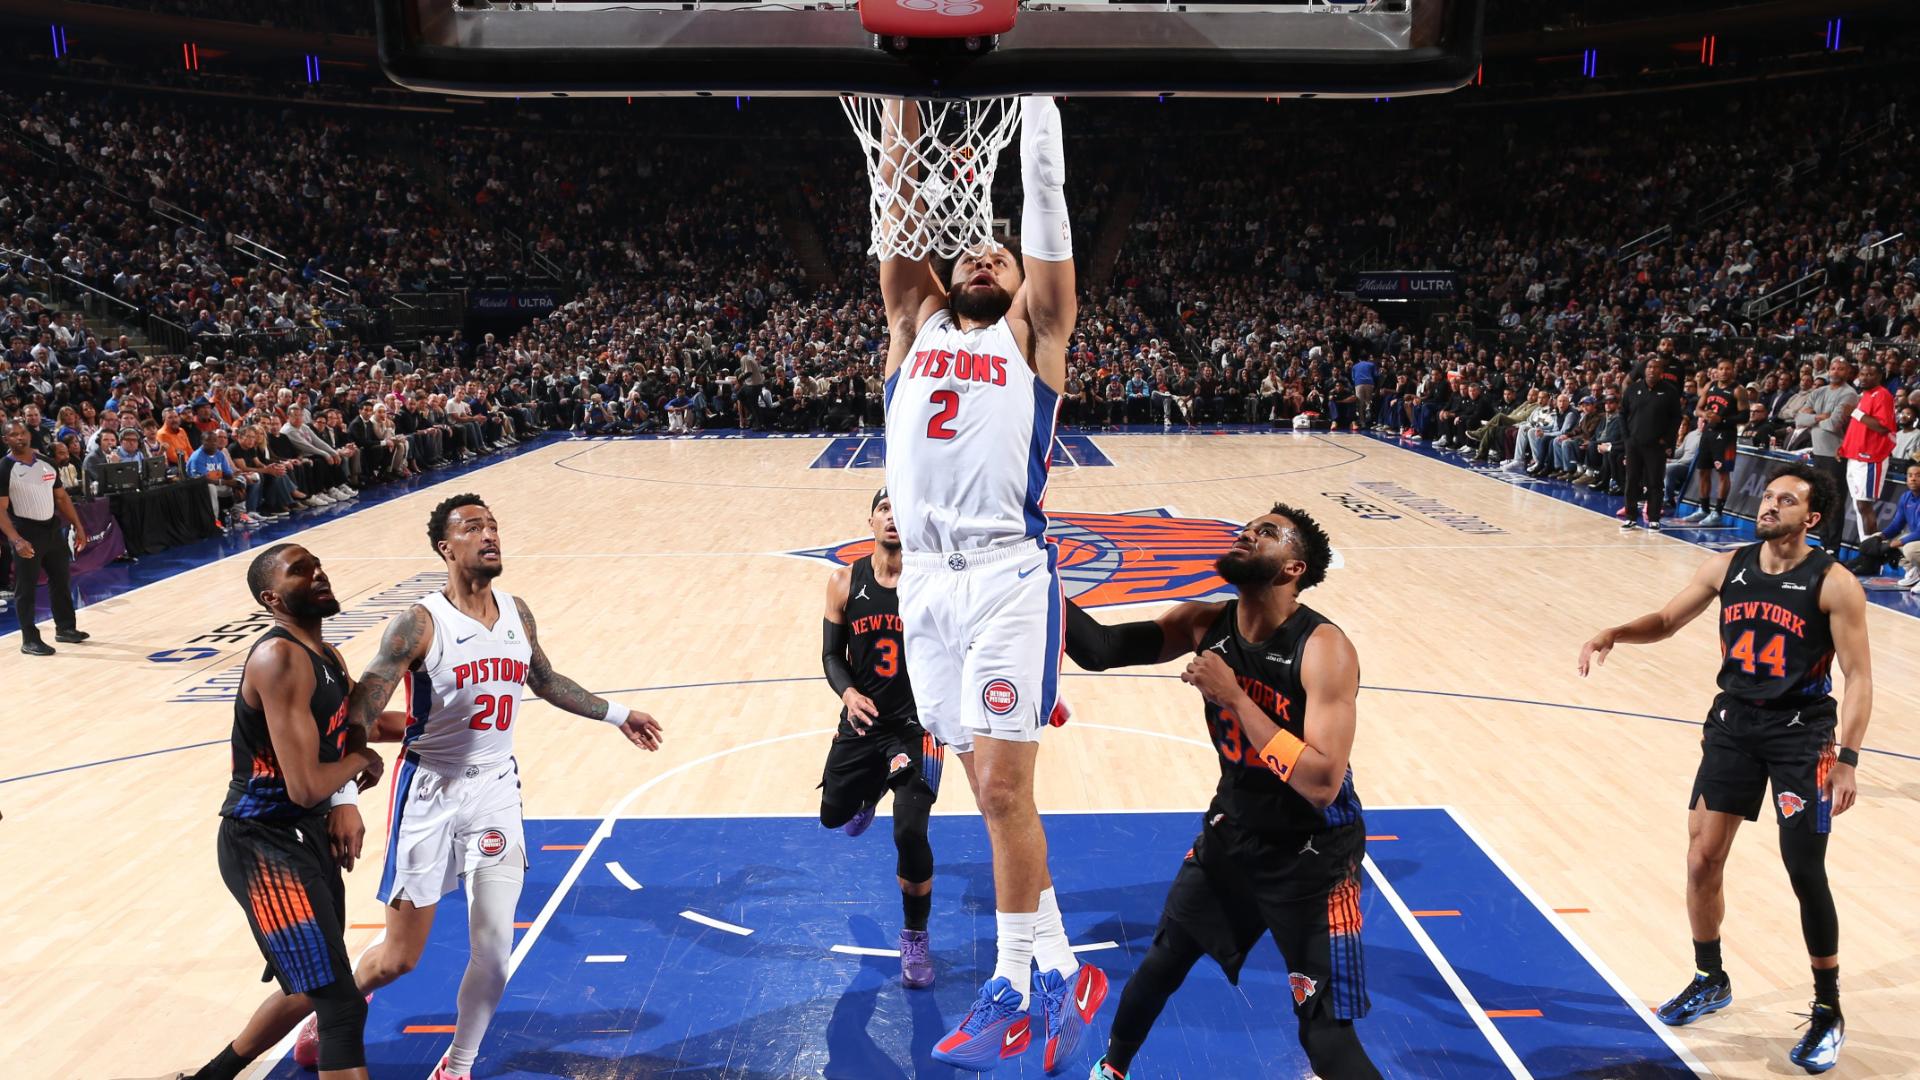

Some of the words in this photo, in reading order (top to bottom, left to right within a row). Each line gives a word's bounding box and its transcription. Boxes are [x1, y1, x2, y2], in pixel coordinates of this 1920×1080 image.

[519, 298, 554, 307] ULTRA
[1410, 280, 1454, 290] ULTRA
[909, 349, 1007, 386] PISONS
[927, 389, 960, 440] 2
[1320, 491, 1386, 513] CHASE
[186, 609, 275, 644] ASE
[852, 615, 883, 635] NEW
[884, 614, 904, 632] YO
[1724, 602, 1760, 624] NEW
[1761, 602, 1806, 638] YORK
[875, 637, 899, 677] 3
[1730, 629, 1786, 678] 44
[326, 697, 348, 736] NE
[469, 694, 513, 732] 20
